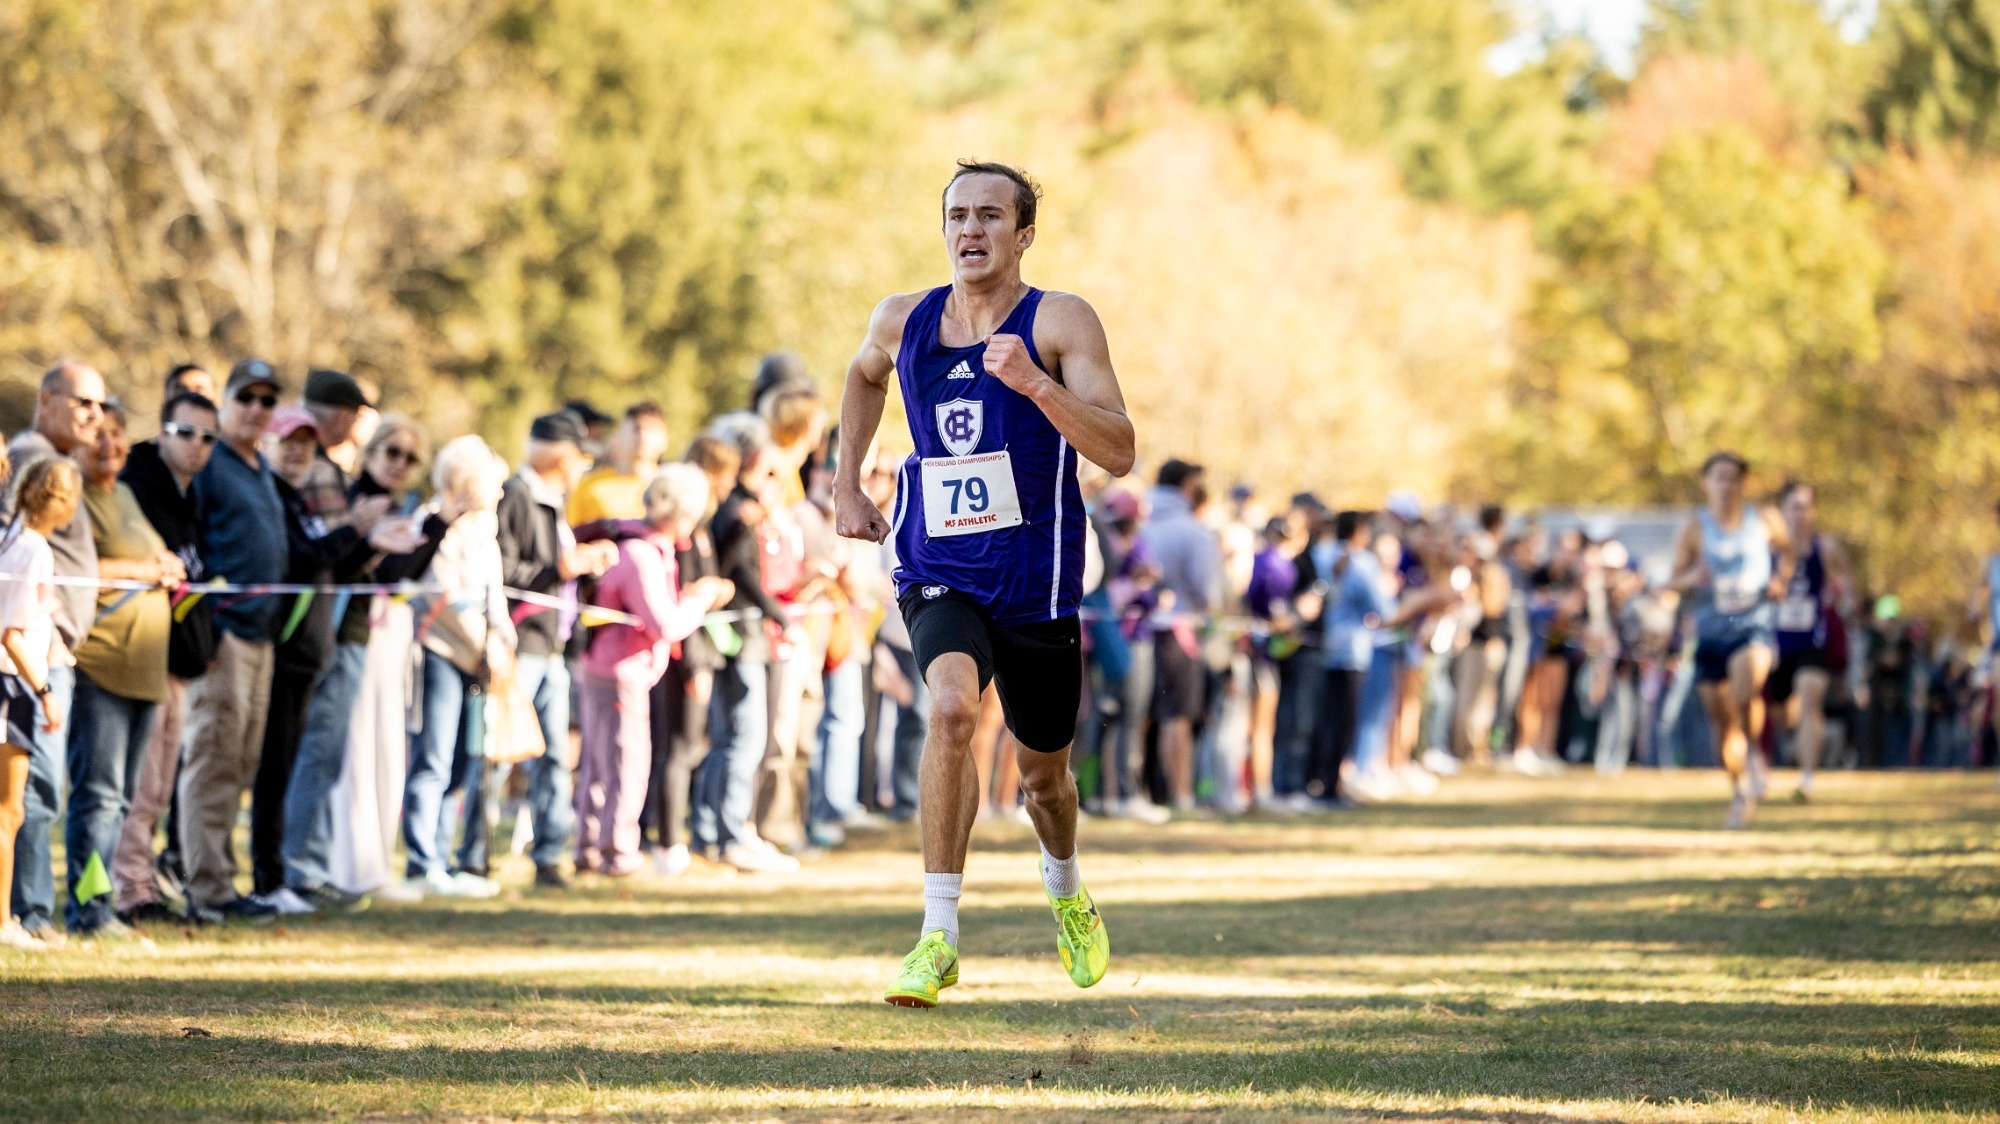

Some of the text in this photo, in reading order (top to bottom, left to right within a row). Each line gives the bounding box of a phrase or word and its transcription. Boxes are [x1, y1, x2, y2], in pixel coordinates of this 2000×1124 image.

[947, 371, 975, 379] adidas
[958, 454, 1001, 465] CHAMPIONSHIPS
[942, 477, 989, 514] 79
[957, 514, 996, 526] ATHLETIC
